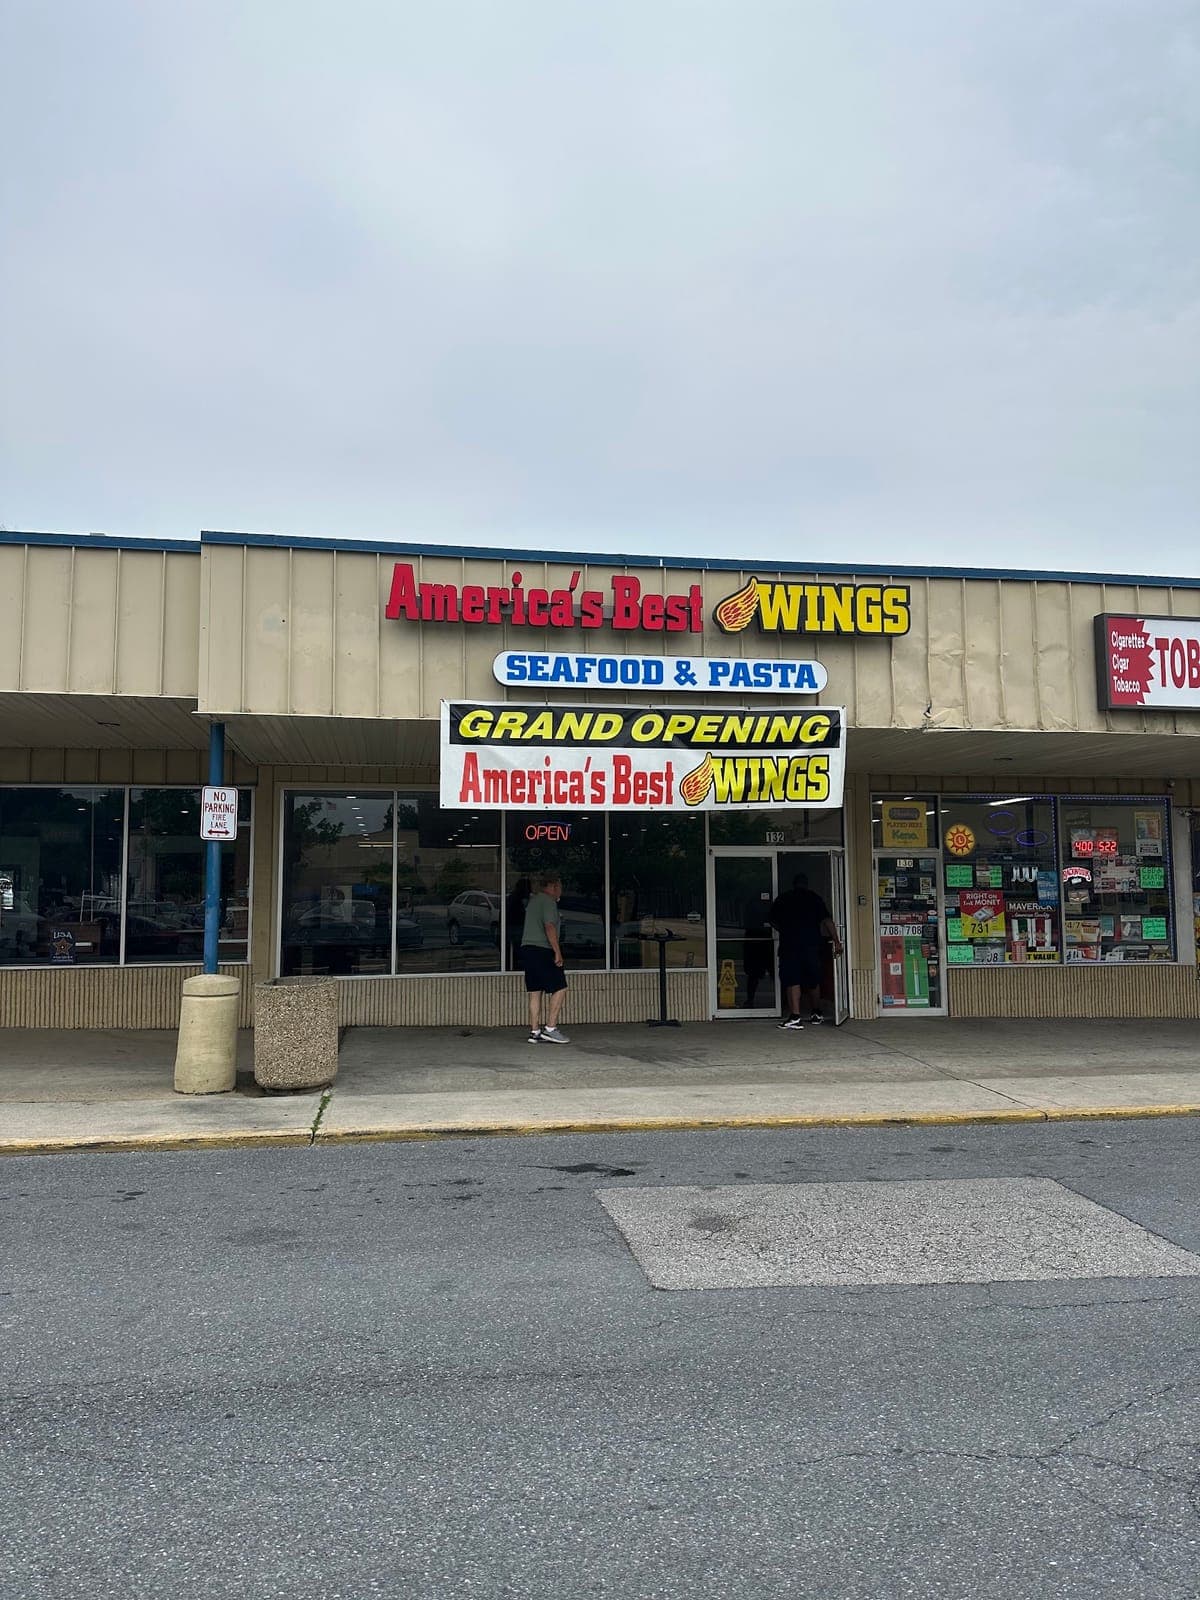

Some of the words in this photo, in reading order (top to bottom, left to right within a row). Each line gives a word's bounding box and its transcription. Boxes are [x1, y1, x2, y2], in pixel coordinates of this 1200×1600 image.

[385, 562, 604, 629] America's
[611, 575, 704, 633] Best
[756, 582, 910, 634] WINGS
[1111, 630, 1146, 651] Cigarettes
[1112, 653, 1130, 673] Cigar
[1154, 637, 1200, 689] TOB
[506, 654, 664, 685] SEAFOOD
[674, 660, 698, 686] &
[708, 661, 818, 689] PASTA
[1112, 675, 1141, 693] Tobacco
[458, 709, 624, 741] GRAND
[630, 712, 831, 744] OPENING
[459, 751, 606, 805] America's
[612, 754, 675, 805] Best
[710, 756, 829, 803] WINGS
[213, 791, 227, 802] NO
[204, 802, 236, 814] PARKING
[212, 813, 227, 821] FIRE
[210, 821, 228, 829] LANE
[525, 824, 569, 841] OPEN
[766, 831, 785, 842] 132
[1075, 841, 1094, 851] 400
[1098, 841, 1117, 851] 522
[1011, 865, 1039, 883] JUU
[966, 892, 988, 900] RIGHT
[883, 926, 899, 936] 708
[905, 925, 922, 935] 708
[970, 923, 990, 934] 731
[53, 931, 73, 939] USA
[1033, 952, 1057, 961] VALUE
